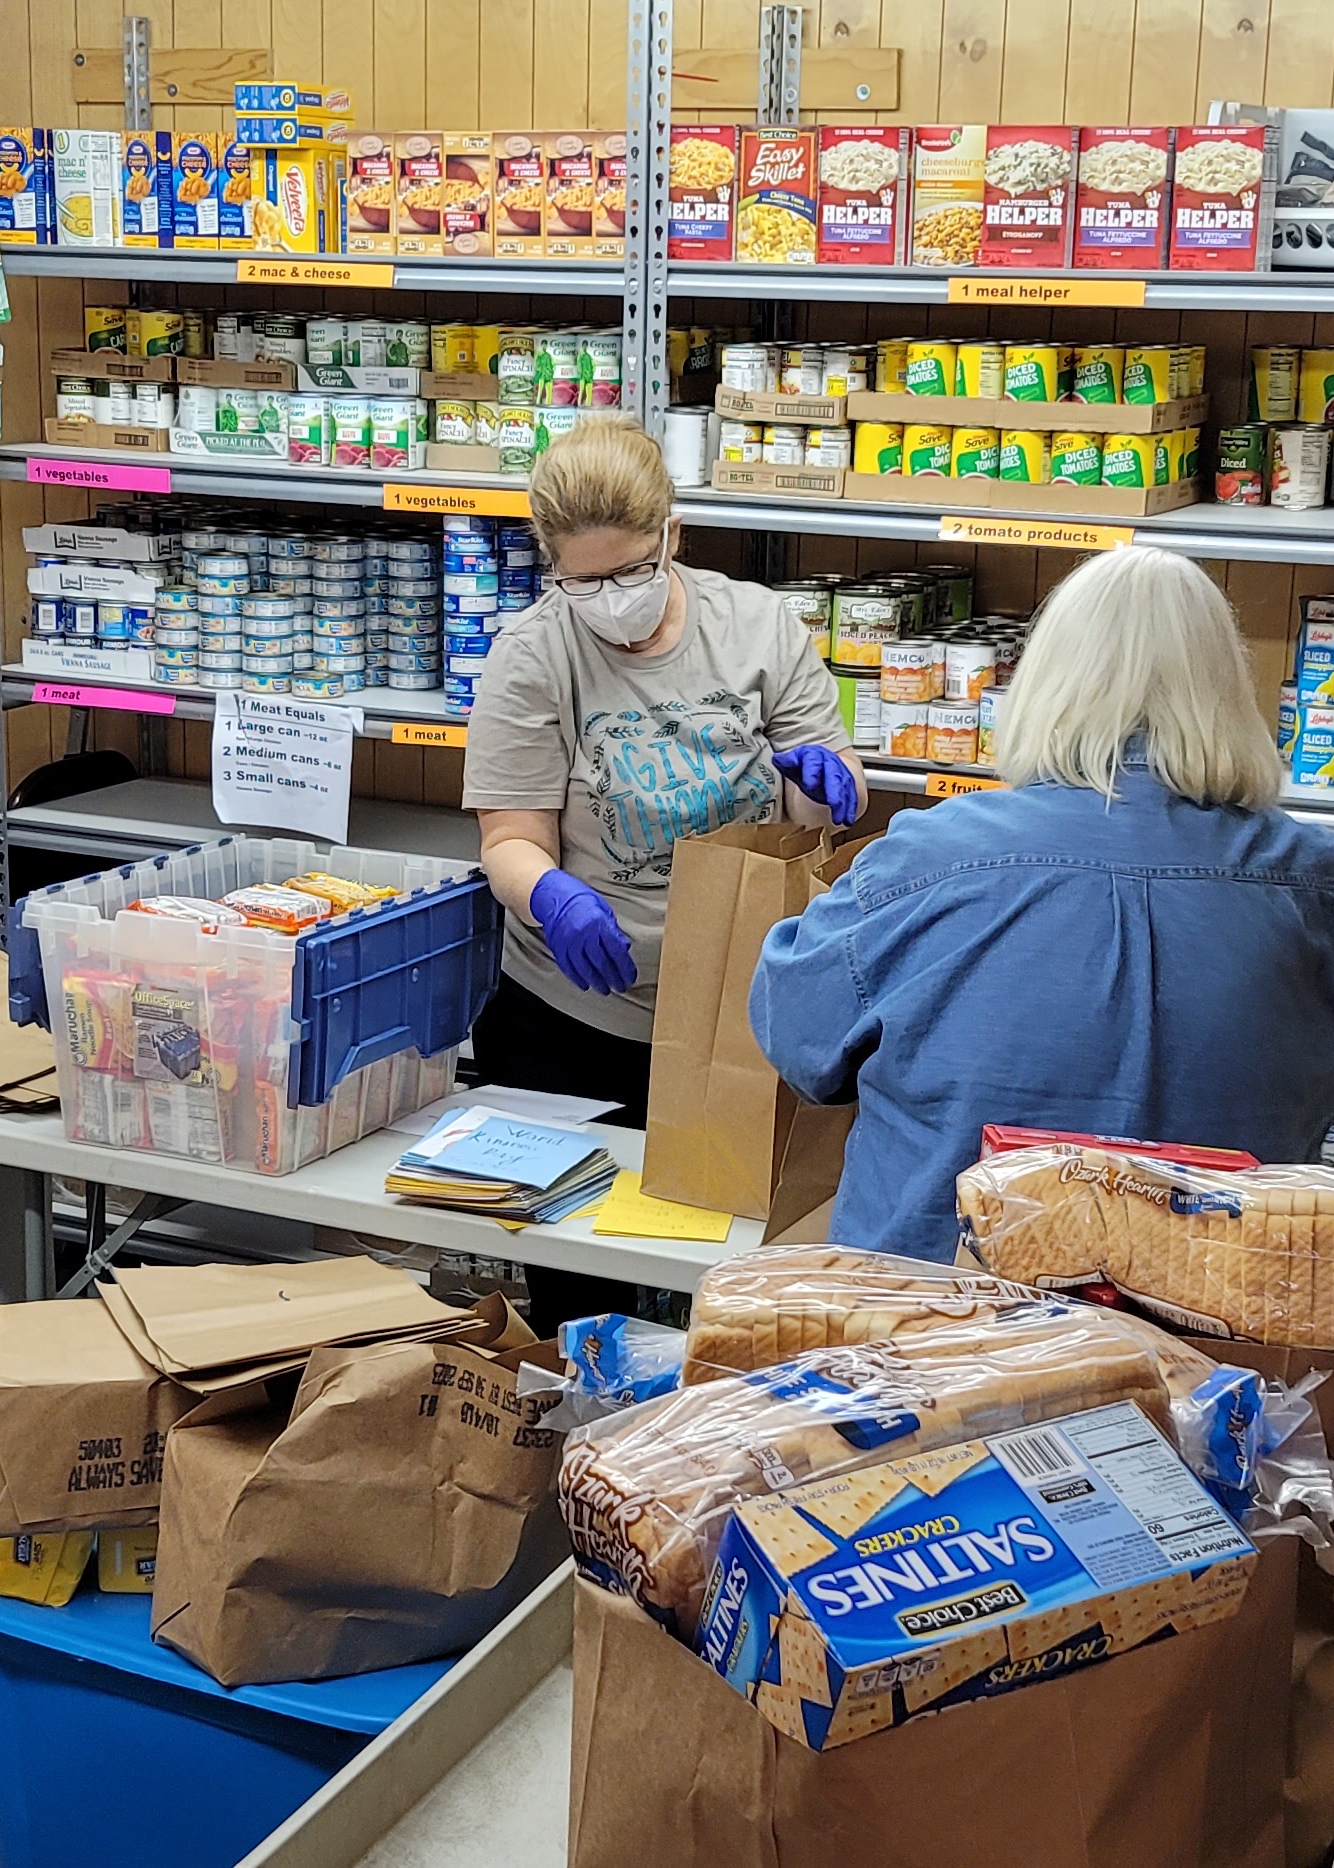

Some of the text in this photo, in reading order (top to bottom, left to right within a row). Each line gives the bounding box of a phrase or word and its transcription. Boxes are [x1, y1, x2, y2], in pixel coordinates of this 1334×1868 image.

[58, 160, 76, 168] mac
[757, 144, 804, 166] Easy
[59, 168, 86, 178] cheese
[748, 163, 806, 187] Skillet
[921, 167, 970, 176] macaroni
[285, 168, 307, 233] Velveeta
[1000, 199, 1049, 207] HAMBURGER
[822, 206, 893, 225] HELPER
[986, 207, 1063, 226] HELPER
[1081, 209, 1158, 229] HELPER
[1177, 209, 1254, 229] HELPER
[248, 266, 351, 280] 2 mac & cheese
[962, 286, 1071, 301] 1 meal helper
[550, 340, 576, 349] Green
[316, 368, 343, 378] Green
[909, 360, 935, 373] DICED
[1007, 364, 1036, 378] DICED
[318, 376, 344, 387] Giant
[1066, 448, 1097, 463] DICED
[1220, 458, 1247, 469] Diced
[36, 467, 109, 484] 1 vegetables
[1060, 458, 1099, 475] TOMATOES
[394, 494, 476, 510] 1 vegetables
[969, 524, 1022, 539] tomato
[1027, 528, 1098, 545] products
[1304, 651, 1331, 662] SLICED
[42, 687, 81, 700] 1 meat
[241, 700, 326, 722] 1 Meat Equals
[225, 720, 231, 731] 1
[238, 719, 274, 734] Large
[278, 727, 301, 738] can
[403, 728, 447, 742] 1 meat
[1303, 734, 1332, 745] SLICED
[223, 746, 231, 757] 2
[236, 746, 287, 761] Medium
[291, 753, 320, 766] cans
[621, 722, 740, 792] GIVE
[223, 771, 232, 781] 3
[236, 770, 274, 784] Small
[277, 776, 307, 789] cans
[938, 780, 947, 792] 2
[508, 1124, 567, 1147] World
[1060, 1157, 1111, 1190] Ozark
[1113, 1170, 1169, 1205] Hearth
[1177, 1193, 1200, 1205] WHITE
[67, 1461, 127, 1493] ALWAYS
[563, 1444, 653, 1550] Ozark
[1148, 1508, 1220, 1535] Calories 60
[854, 1514, 961, 1559] CRACKERS
[1169, 1535, 1244, 1562] Nutrition Facts
[807, 1515, 1056, 1617] SALTINES
[972, 1585, 1023, 1610] Best
[984, 1633, 1114, 1689] CRACKERS
